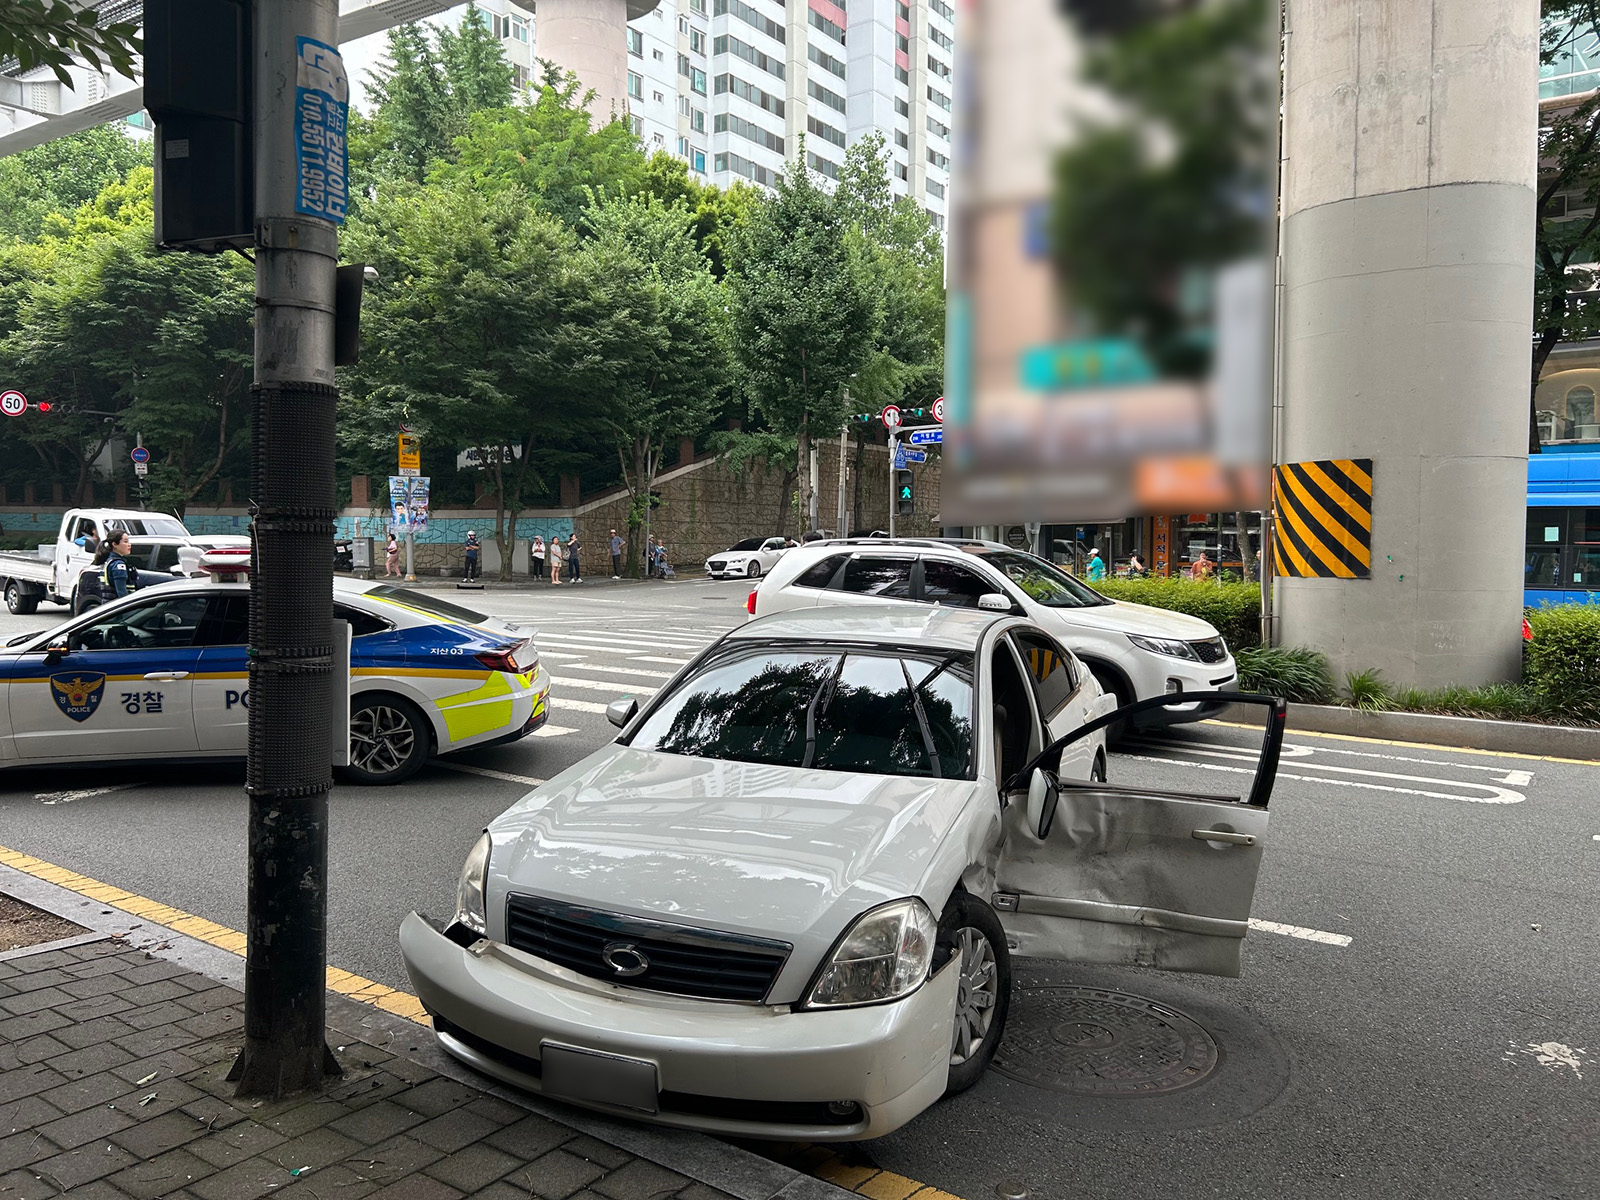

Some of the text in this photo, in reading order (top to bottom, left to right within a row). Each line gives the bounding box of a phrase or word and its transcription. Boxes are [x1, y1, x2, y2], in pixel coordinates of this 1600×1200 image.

[301, 93, 326, 212] 010.5511.9952
[325, 130, 346, 219] 컨테이너
[5, 397, 20, 410] 50
[430, 647, 449, 655] 지산
[121, 691, 164, 714] 경찰
